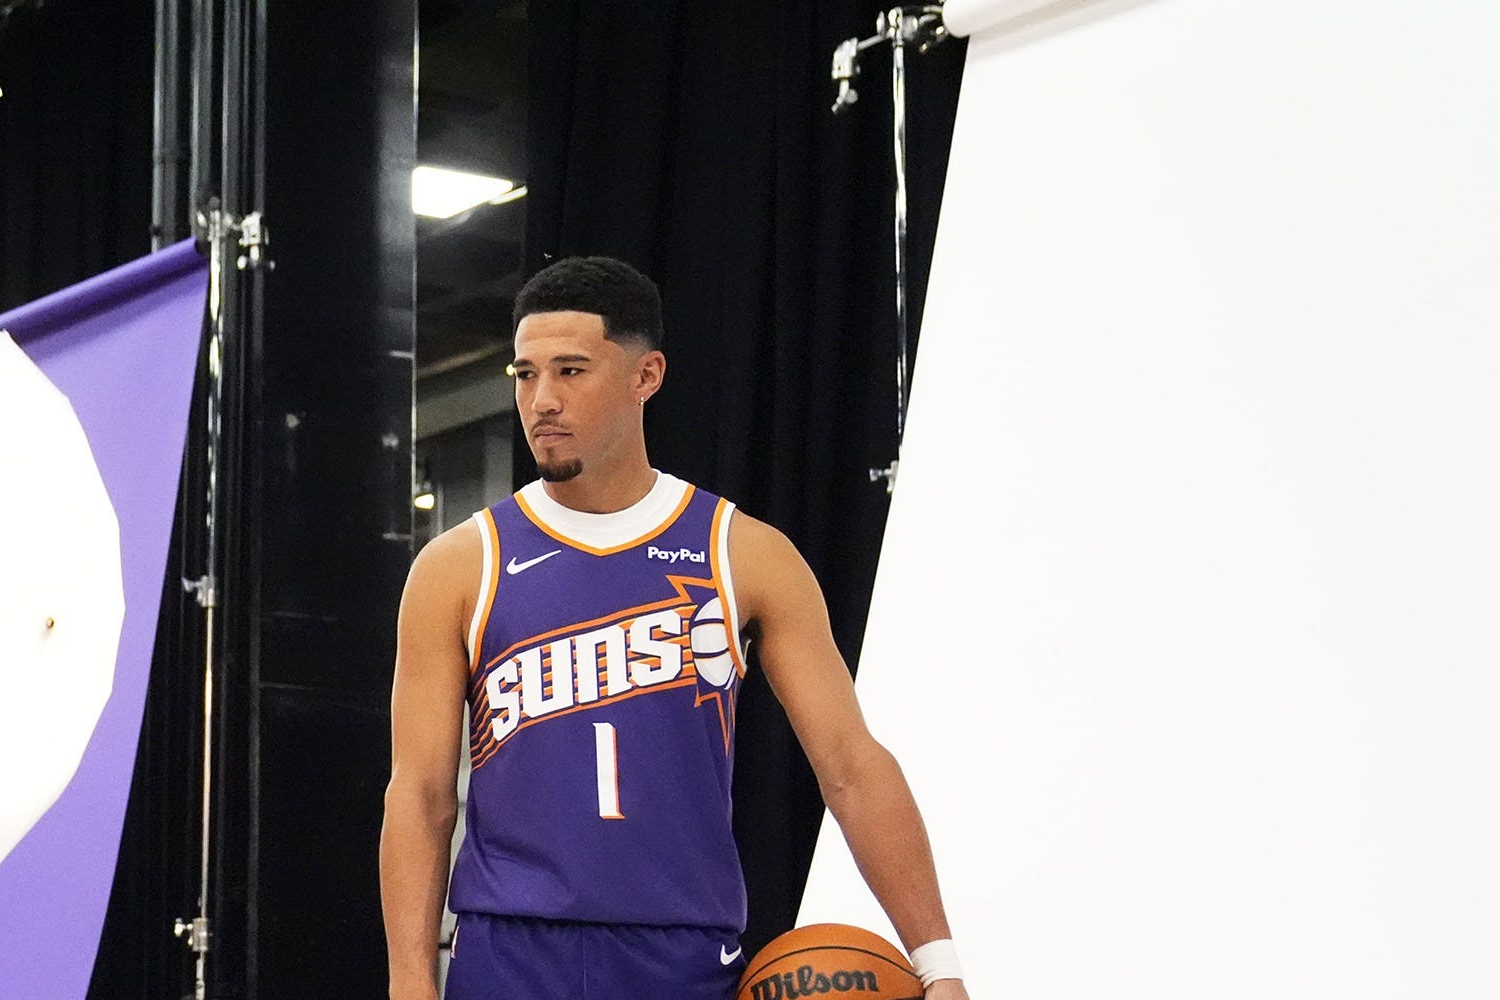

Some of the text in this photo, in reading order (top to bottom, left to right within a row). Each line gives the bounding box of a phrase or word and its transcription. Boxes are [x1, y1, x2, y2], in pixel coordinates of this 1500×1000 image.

[647, 546, 706, 564] PayPal
[485, 609, 683, 742] SUNS
[592, 722, 626, 820] 1
